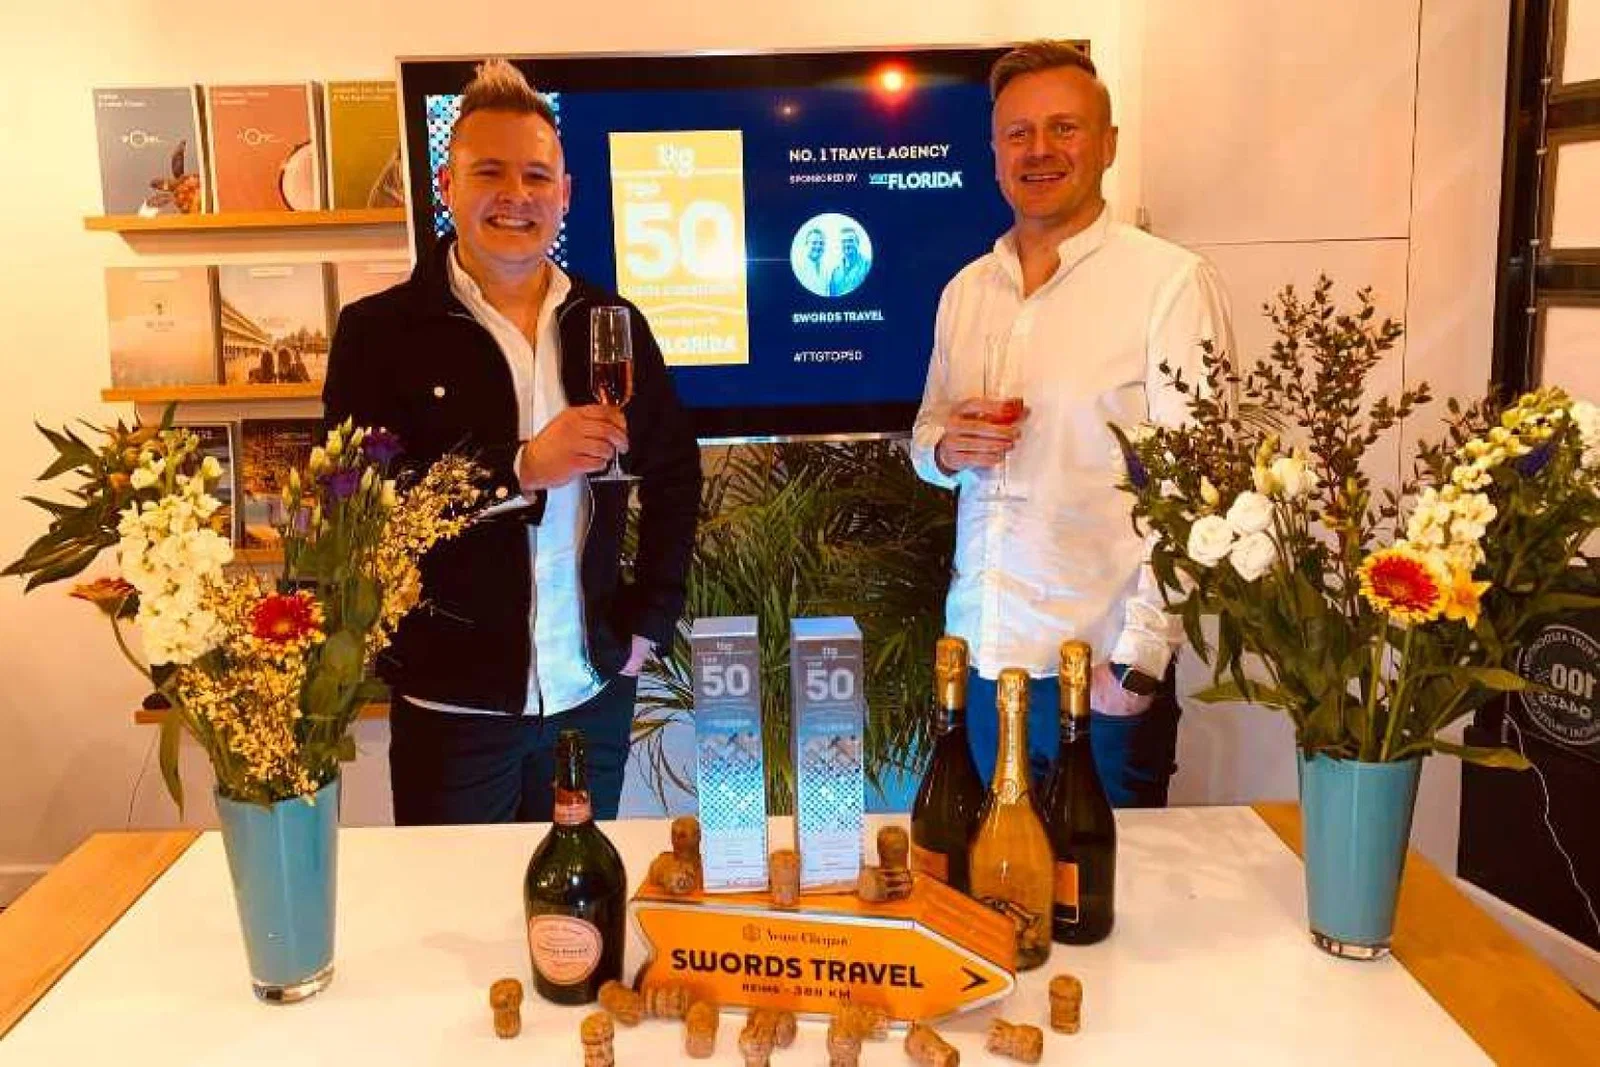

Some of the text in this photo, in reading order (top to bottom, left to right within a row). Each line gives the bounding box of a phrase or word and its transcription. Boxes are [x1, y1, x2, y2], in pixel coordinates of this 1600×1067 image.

[789, 144, 950, 163] NO. 1 TRAVEL AGENCY
[886, 171, 963, 190] FLORIDA
[624, 200, 738, 280] 50
[792, 309, 884, 323] SWORDS TRAVEL
[702, 664, 750, 697] 50
[806, 667, 854, 701] 50
[671, 947, 924, 990] SWORDS TRAVEL
